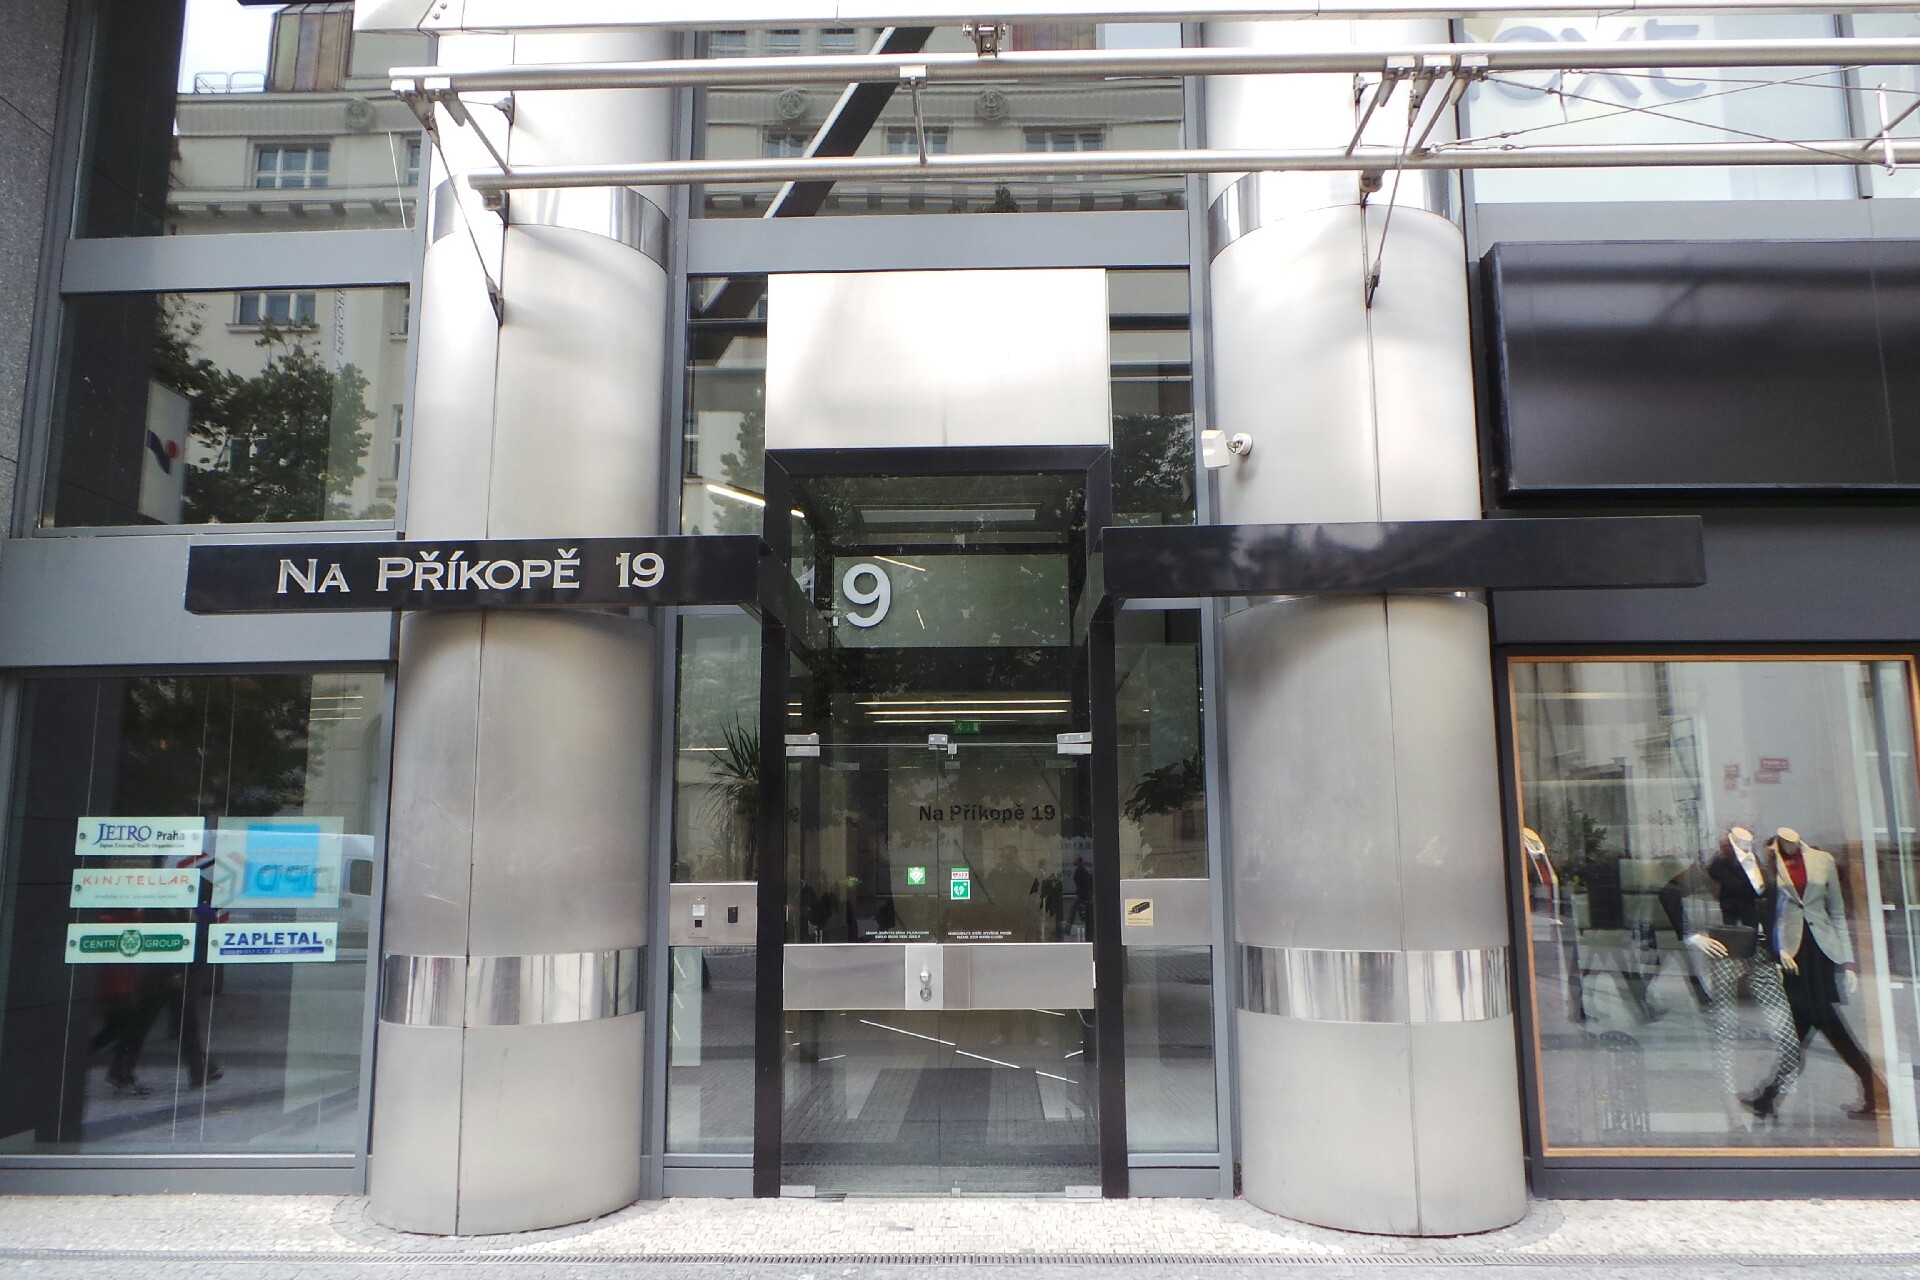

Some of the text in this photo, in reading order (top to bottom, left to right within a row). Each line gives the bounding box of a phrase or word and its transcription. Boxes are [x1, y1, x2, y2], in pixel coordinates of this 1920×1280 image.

[375, 547, 580, 593] PŘÍKOPĚ
[615, 551, 665, 589] 19
[919, 803, 1056, 824] Na Příkopě 19
[92, 823, 185, 845] JETRO Praha
[82, 875, 189, 886] KINSTELLAR
[82, 938, 181, 949] CENTR GROUP
[224, 931, 322, 946] ZAPLETAL
